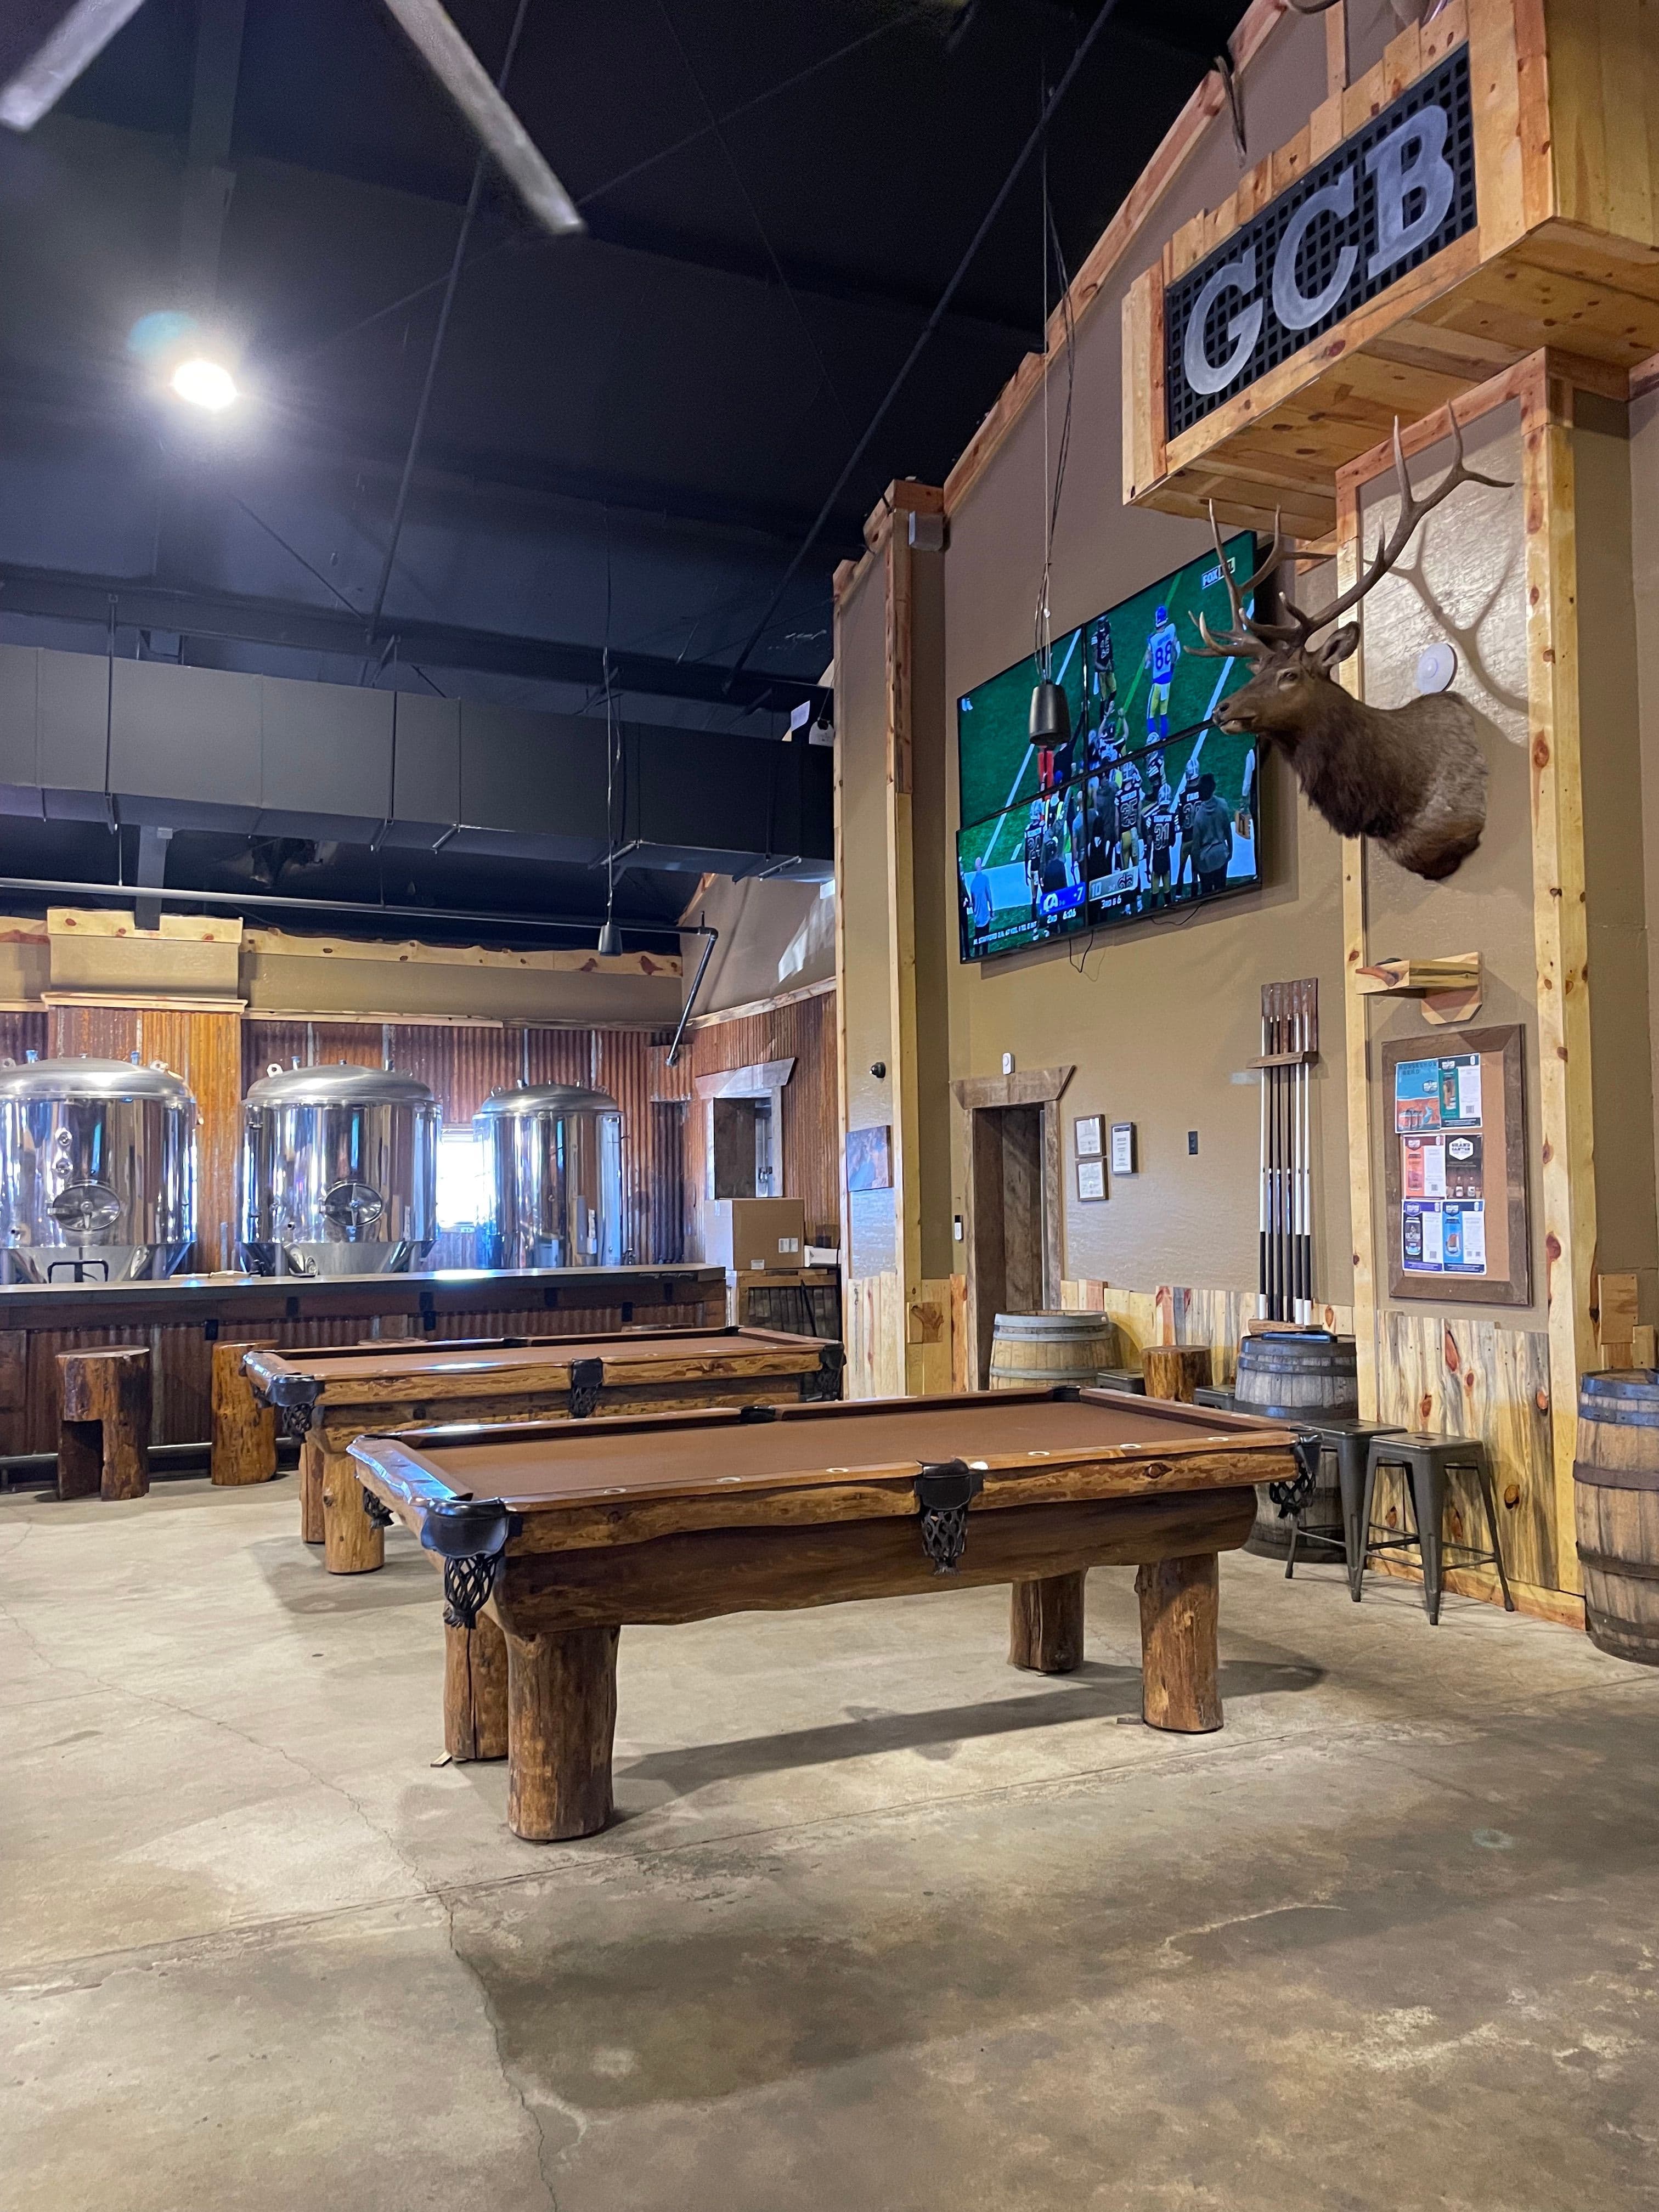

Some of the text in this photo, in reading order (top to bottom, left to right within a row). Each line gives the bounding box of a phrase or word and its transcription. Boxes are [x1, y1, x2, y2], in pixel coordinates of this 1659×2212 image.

[1184, 105, 1454, 395] GCB
[1202, 568, 1218, 586] FOX
[1091, 881, 1102, 897] 10
